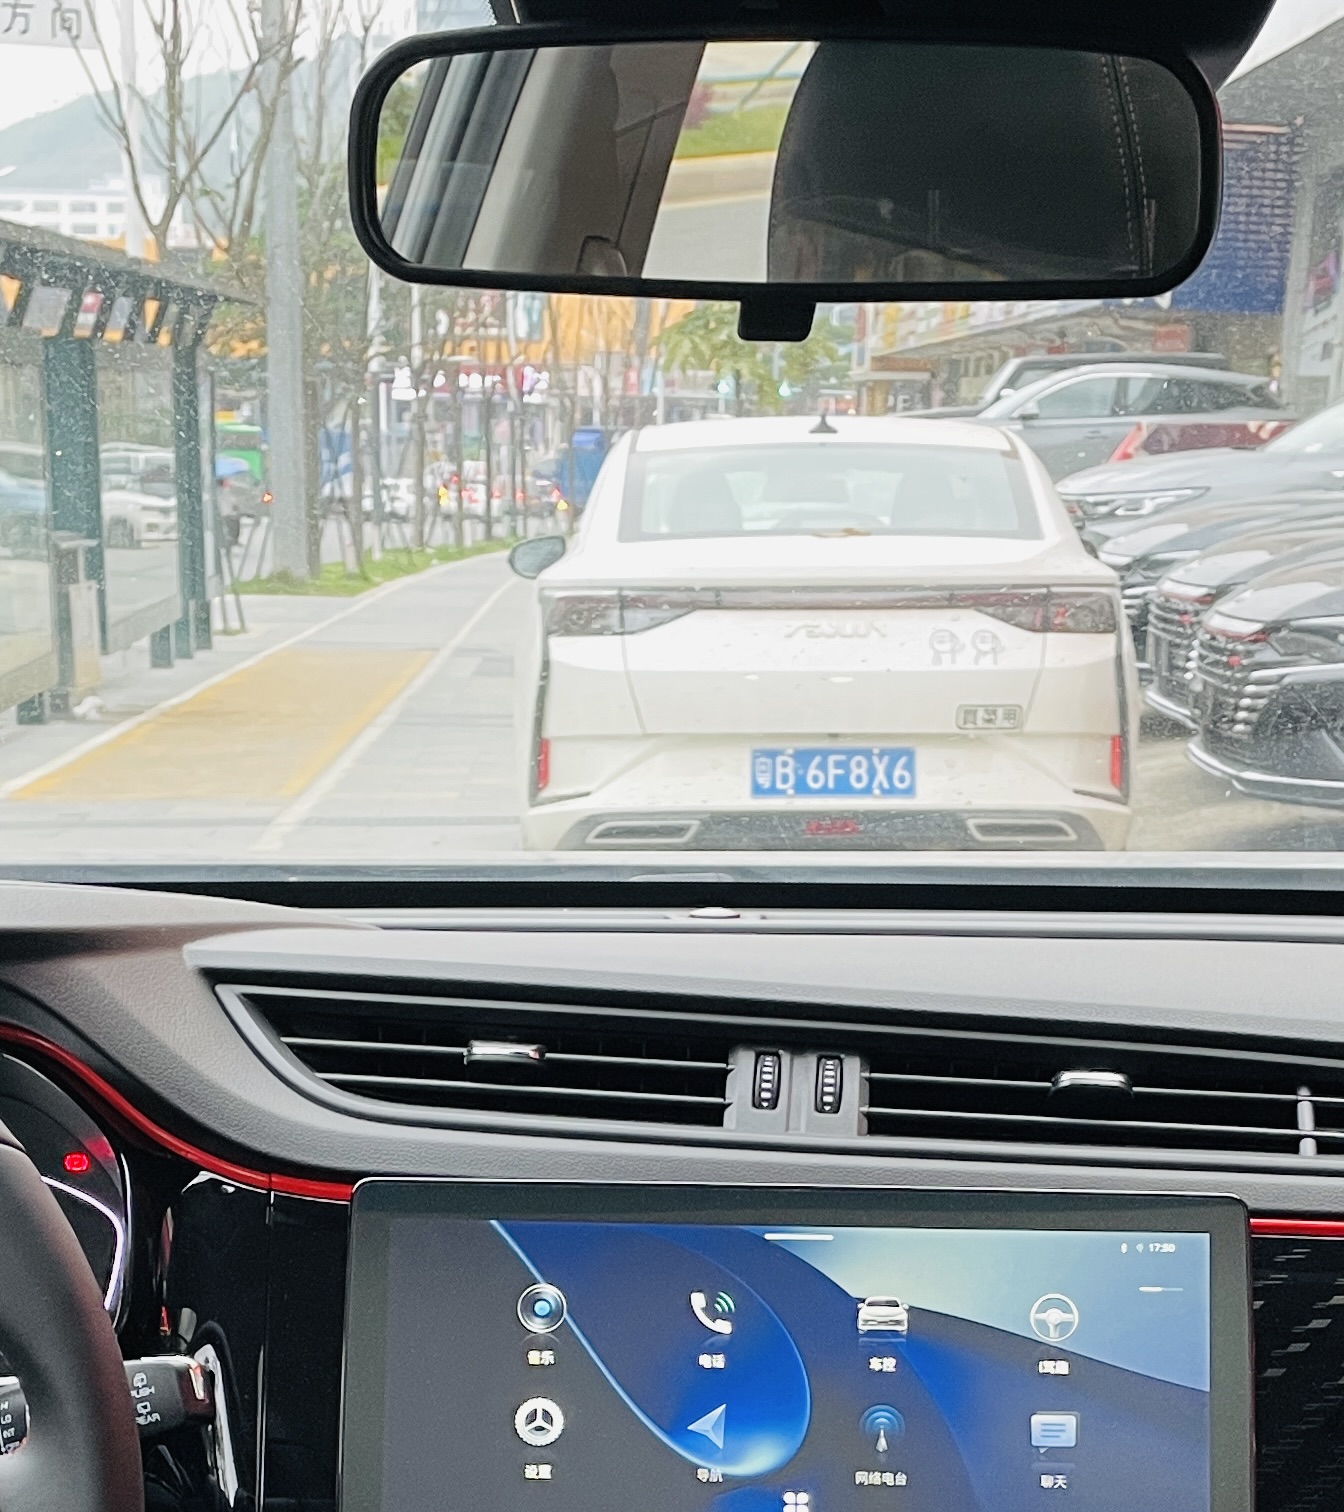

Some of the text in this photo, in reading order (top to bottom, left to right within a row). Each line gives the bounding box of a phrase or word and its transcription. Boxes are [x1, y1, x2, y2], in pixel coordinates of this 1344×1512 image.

[1, 1414, 12, 1425] LO
[855, 1470, 908, 1486] 网络电台
